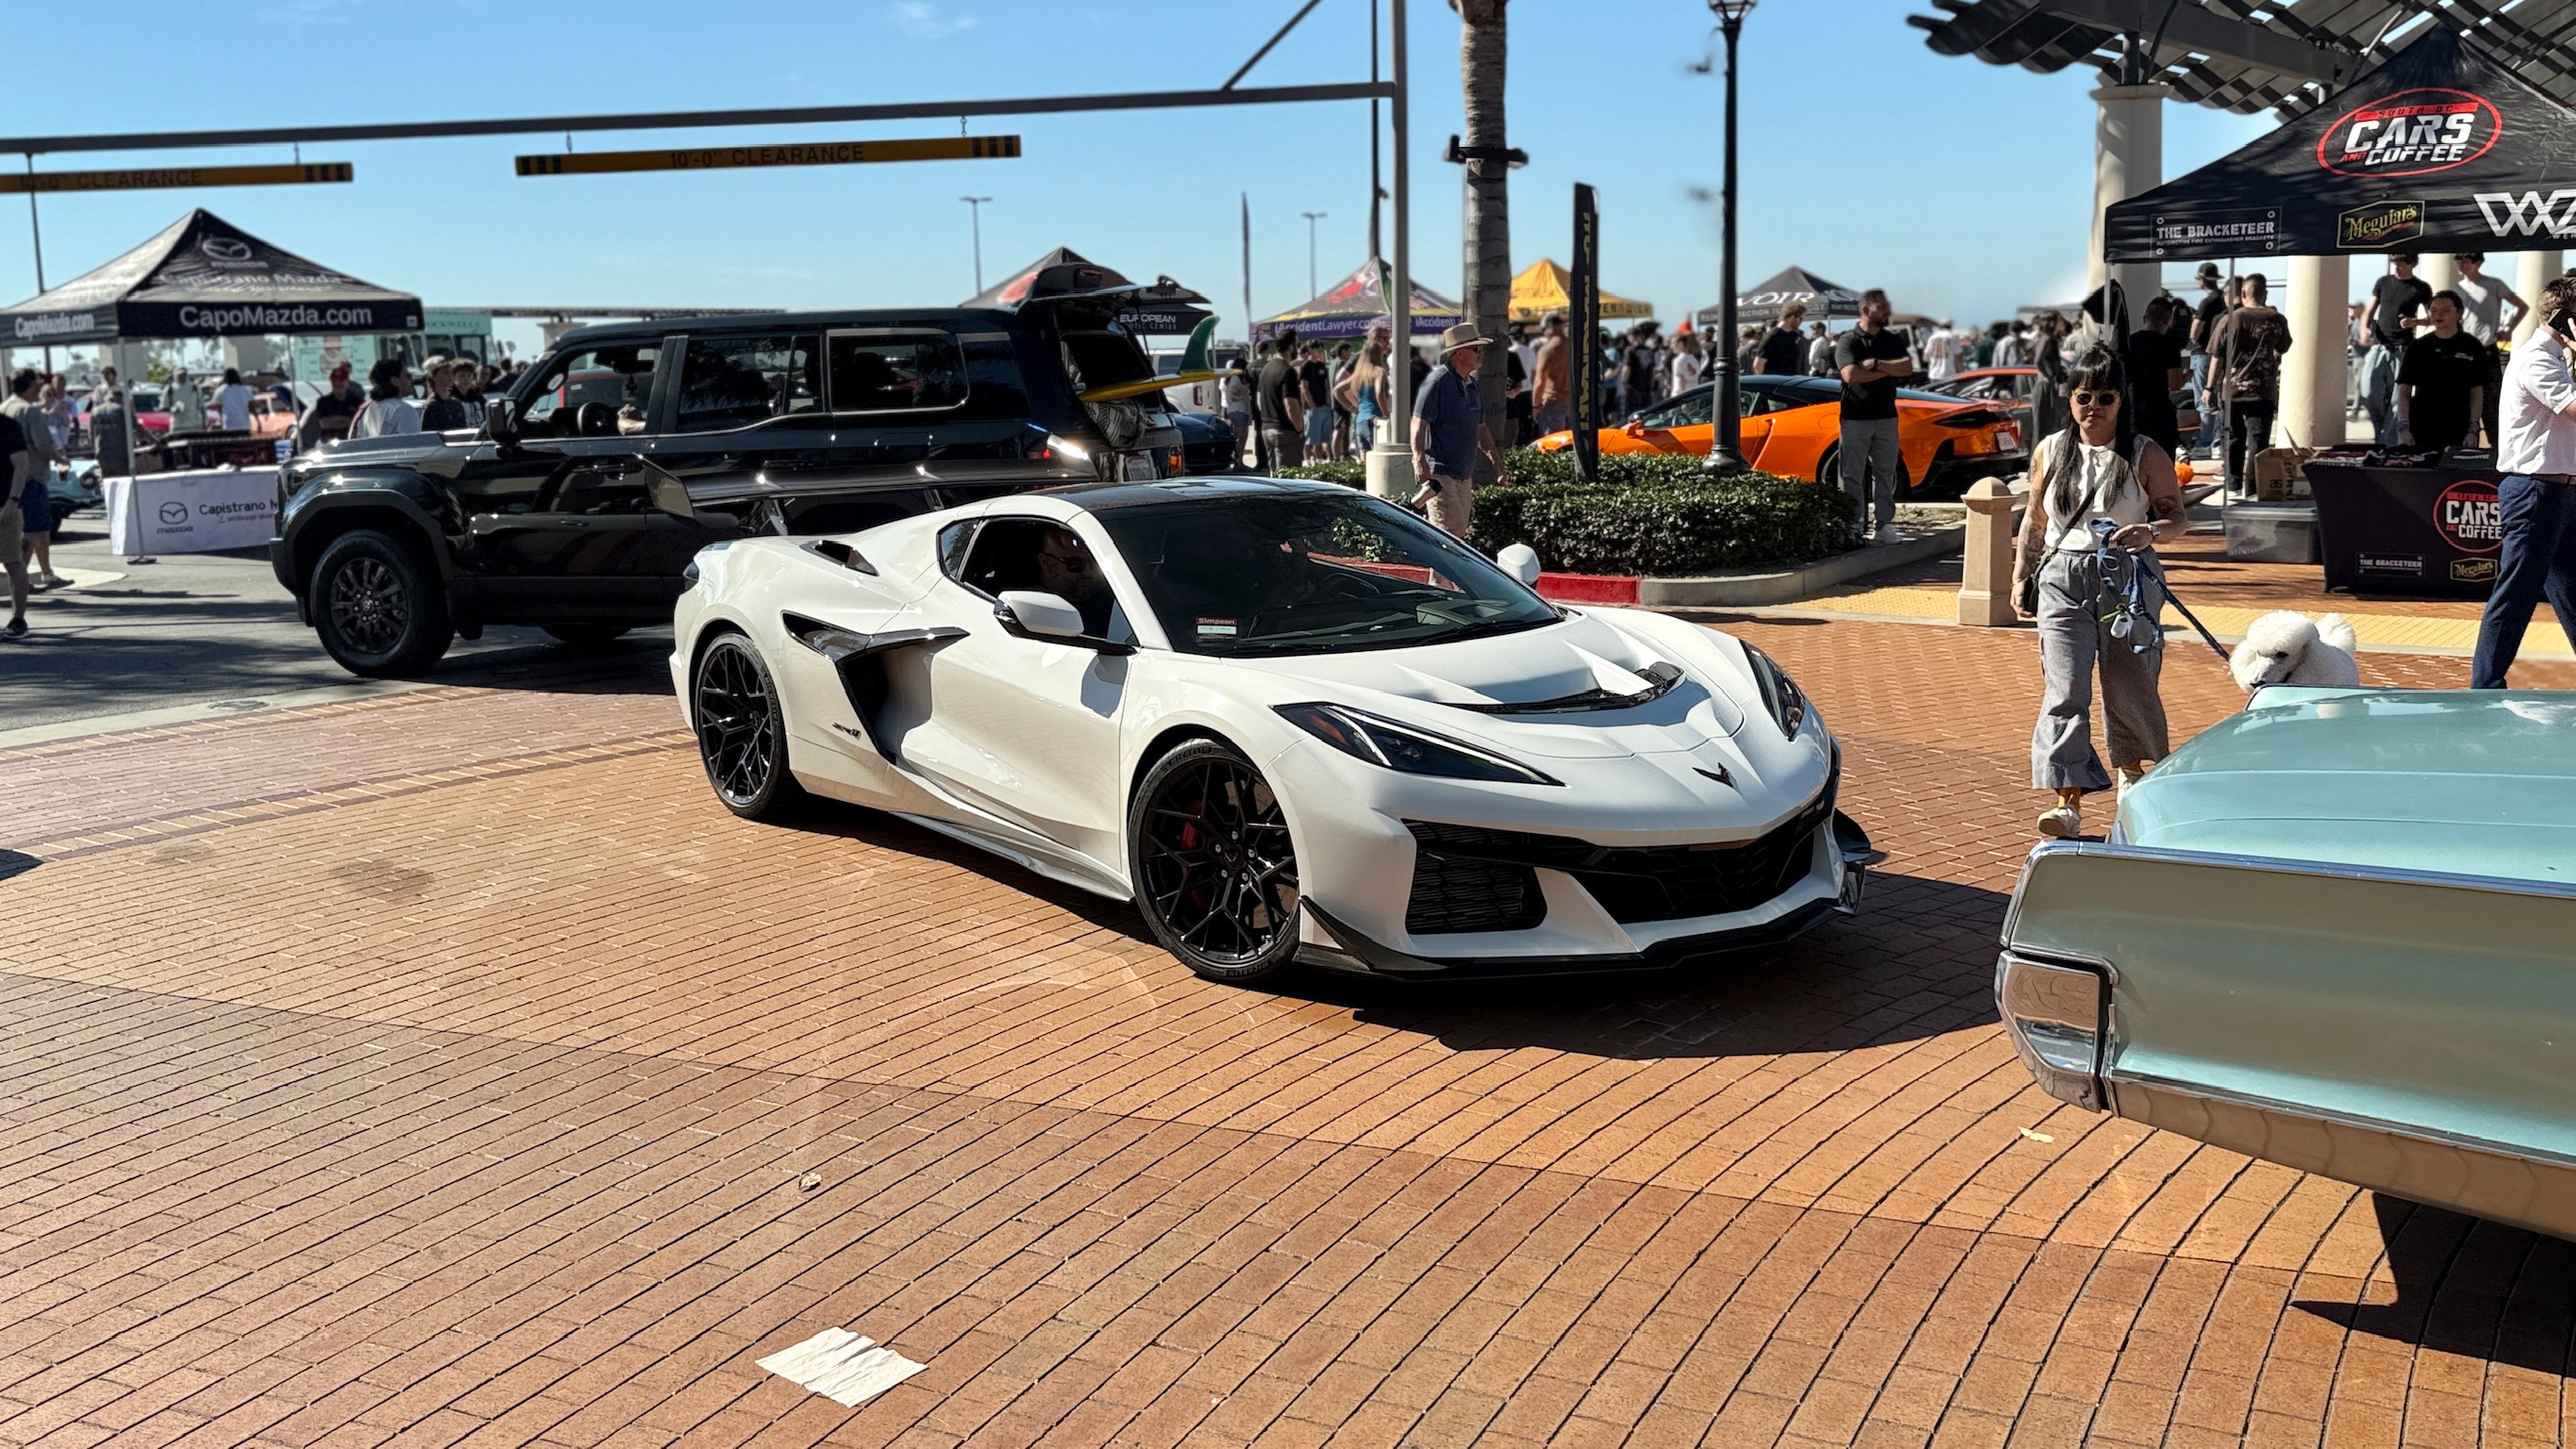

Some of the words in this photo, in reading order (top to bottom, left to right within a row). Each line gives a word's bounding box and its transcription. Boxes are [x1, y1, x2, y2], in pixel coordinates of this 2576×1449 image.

[2378, 107, 2425, 118] SOUTH
[2435, 105, 2453, 113] OC
[2344, 113, 2475, 154] CARS
[732, 145, 864, 165] CLEARANCE
[2339, 153, 2367, 162] AND
[2365, 143, 2467, 166] COFFEE
[77, 170, 203, 189] CLEARANCE
[2156, 227, 2182, 239] THE
[2187, 222, 2275, 238] BRACKETEER
[2344, 206, 2417, 241] Meguiar's
[179, 305, 373, 331] CapoMazda.com
[1738, 308, 1769, 317] TECTION
[14, 313, 94, 341] CapoMazda.com
[199, 502, 266, 516] Capistrano
[2446, 500, 2501, 525] CARS
[2458, 525, 2502, 540] COFFEE
